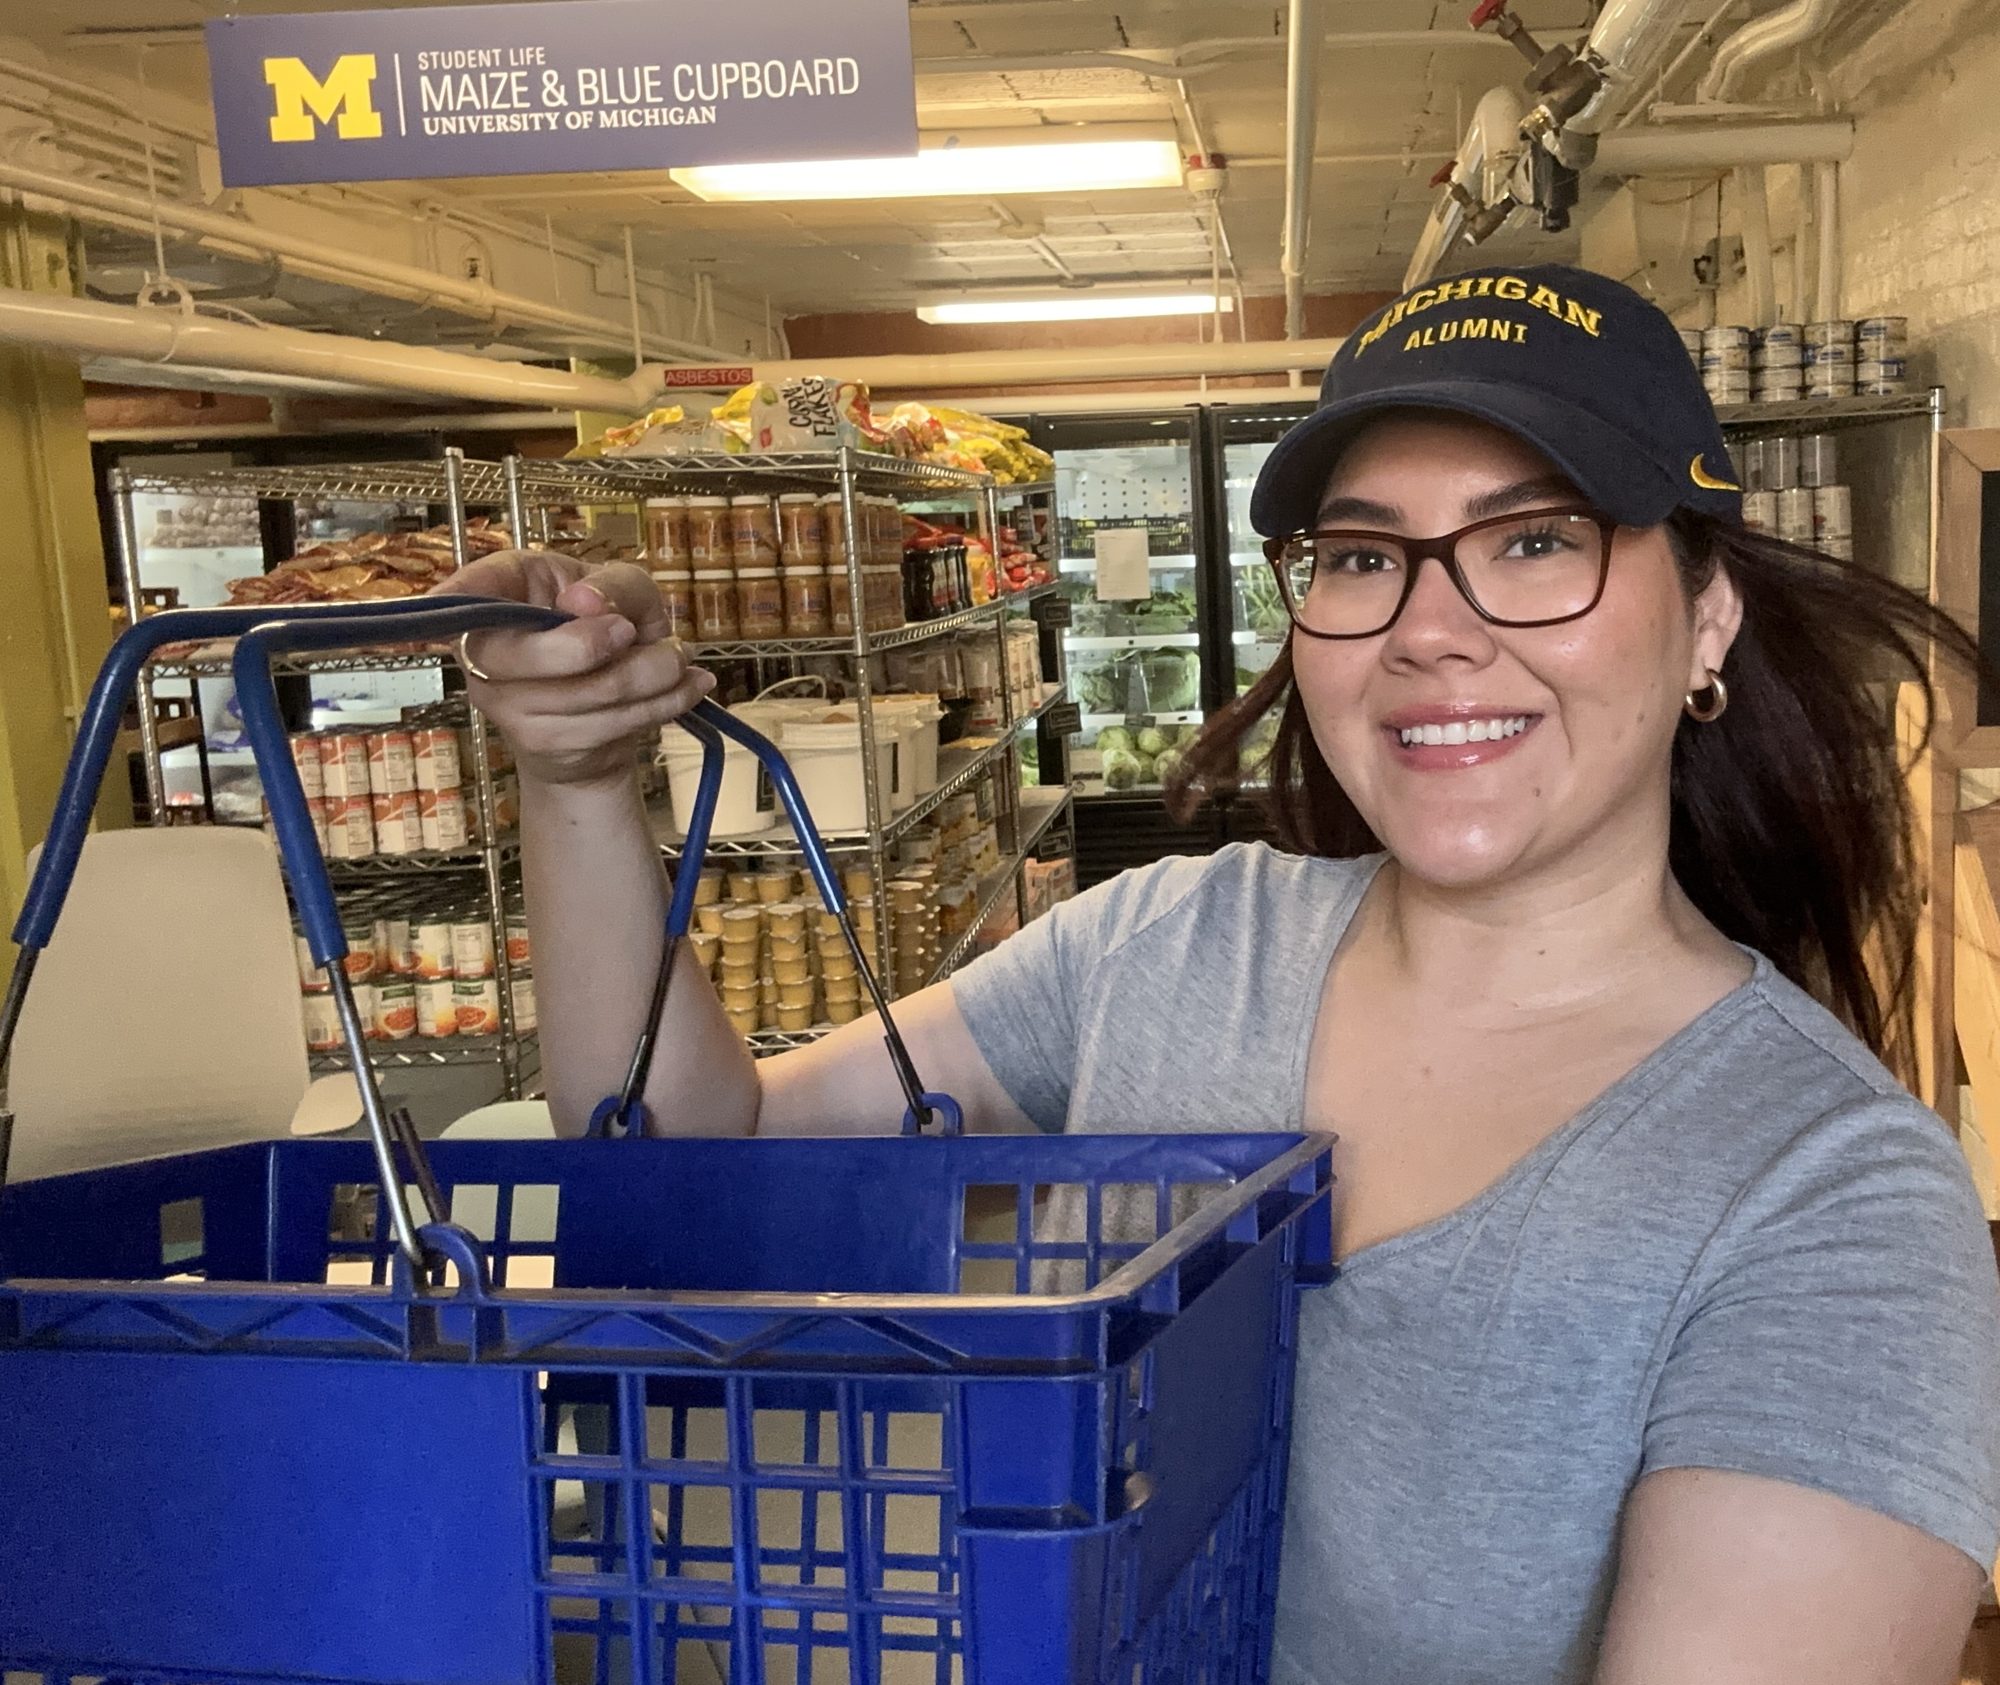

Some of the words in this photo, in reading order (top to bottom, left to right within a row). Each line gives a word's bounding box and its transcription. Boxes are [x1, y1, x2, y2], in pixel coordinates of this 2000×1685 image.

[418, 48, 502, 70] STUDENT
[509, 46, 546, 66] LIFE
[264, 53, 384, 142] M
[420, 71, 531, 112] MAIZE
[541, 69, 568, 107] &
[577, 65, 664, 105] BLUE
[673, 57, 859, 101] CUPBOARD
[423, 112, 559, 135] UNIVERSITY
[565, 111, 593, 129] OF
[599, 106, 717, 128] MICHIGAN
[1354, 276, 1602, 359] MICHIGAN
[1403, 318, 1528, 351] ALUMNI
[666, 370, 752, 385] ASBESTOS
[781, 386, 812, 428] CORN
[801, 377, 837, 437] FLAKES
